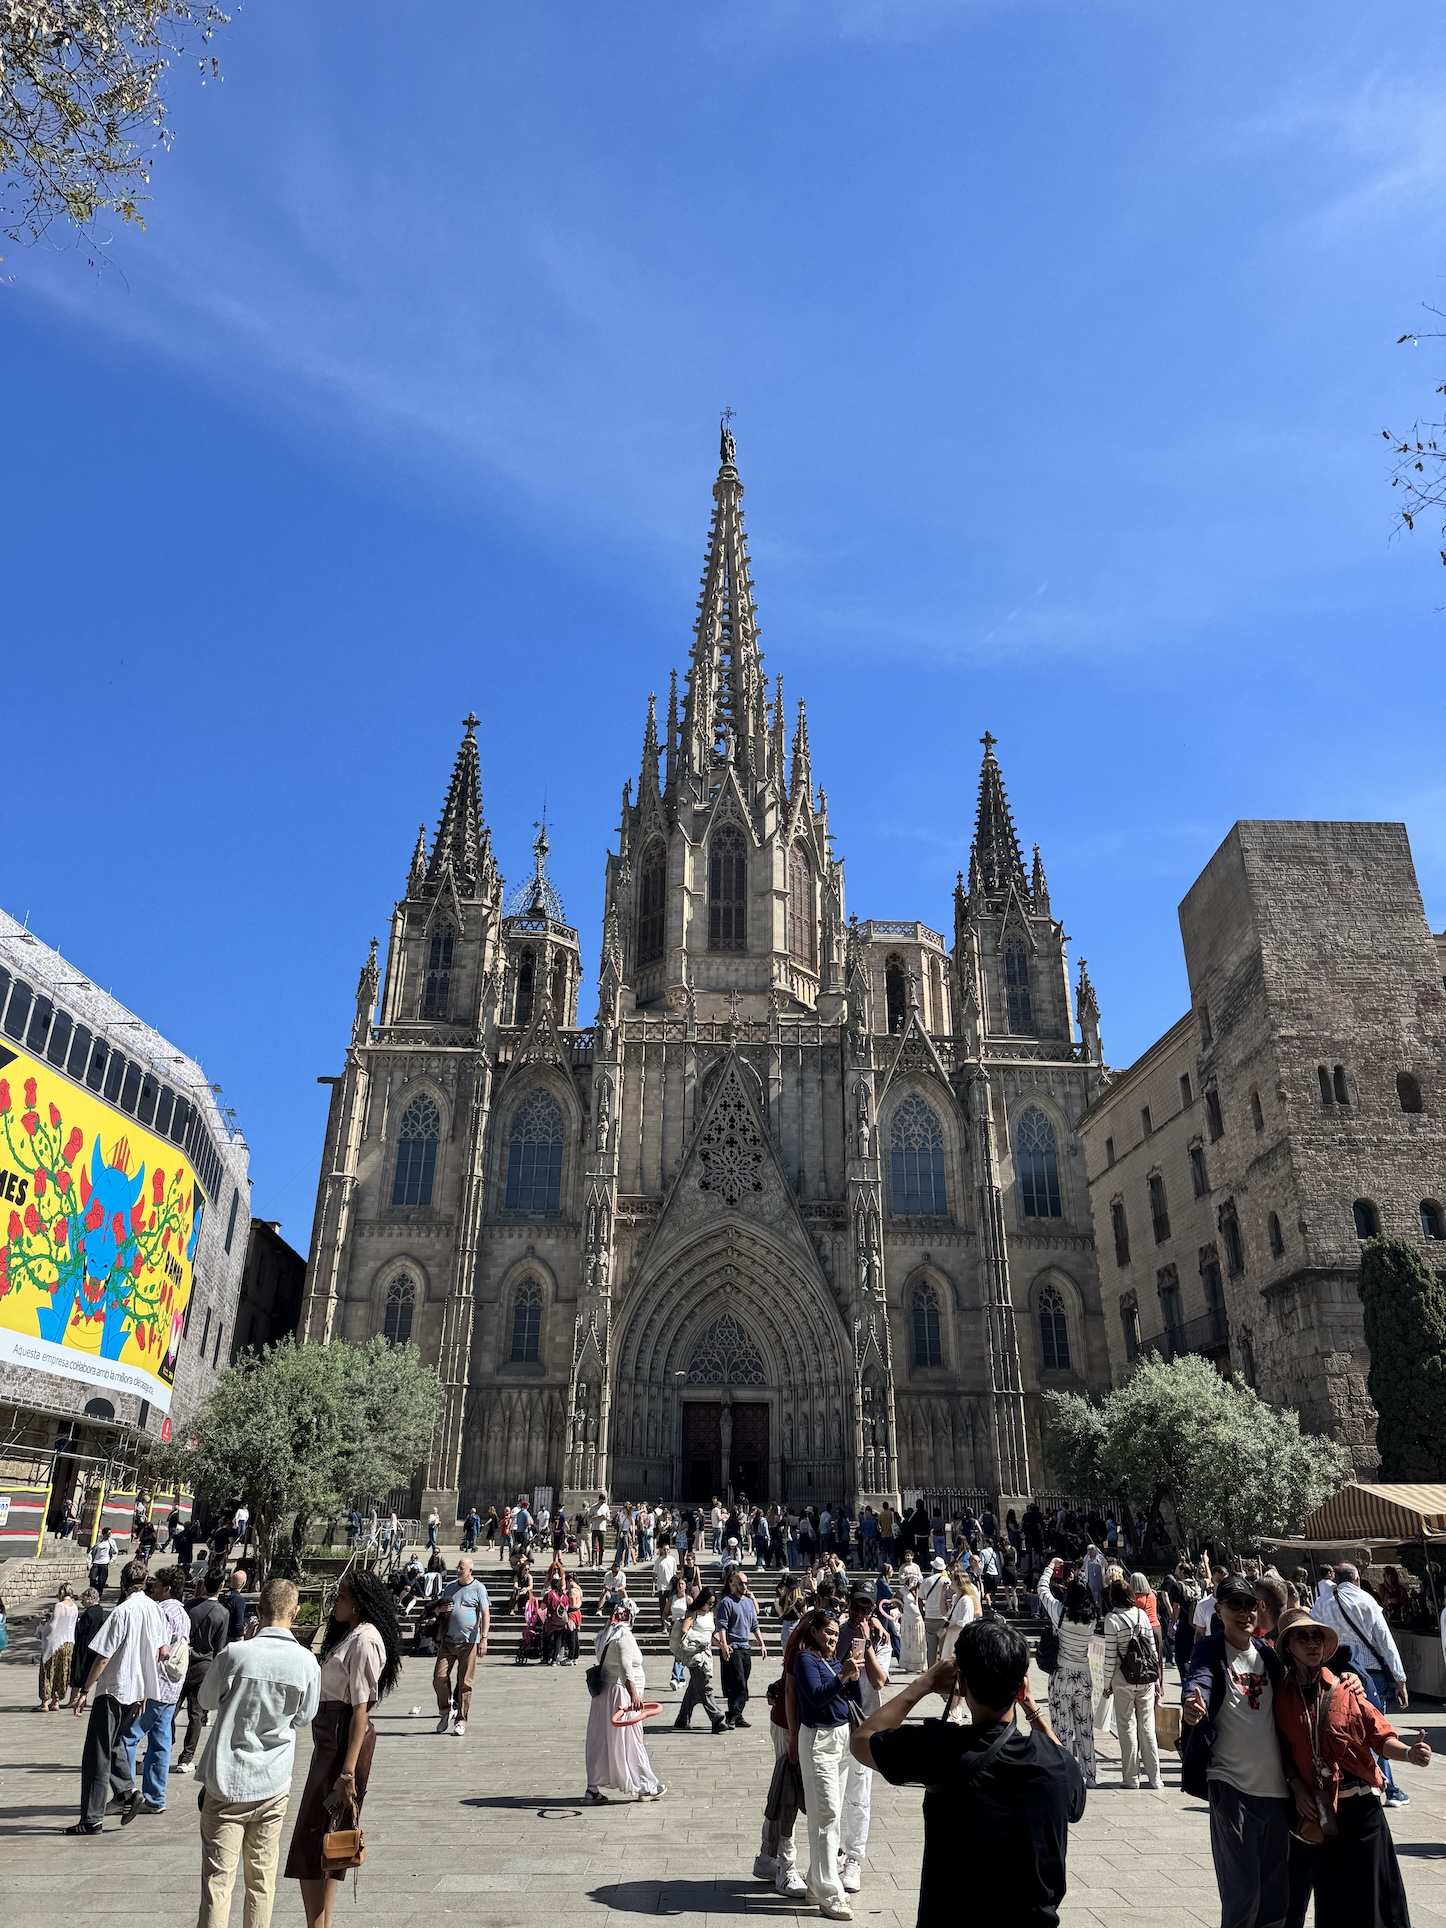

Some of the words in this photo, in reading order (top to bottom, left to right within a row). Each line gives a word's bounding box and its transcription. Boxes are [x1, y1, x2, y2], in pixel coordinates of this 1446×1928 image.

[13, 1344, 40, 1360] Aquesta
[42, 1353, 69, 1368] empresa
[96, 1368, 110, 1379] amb
